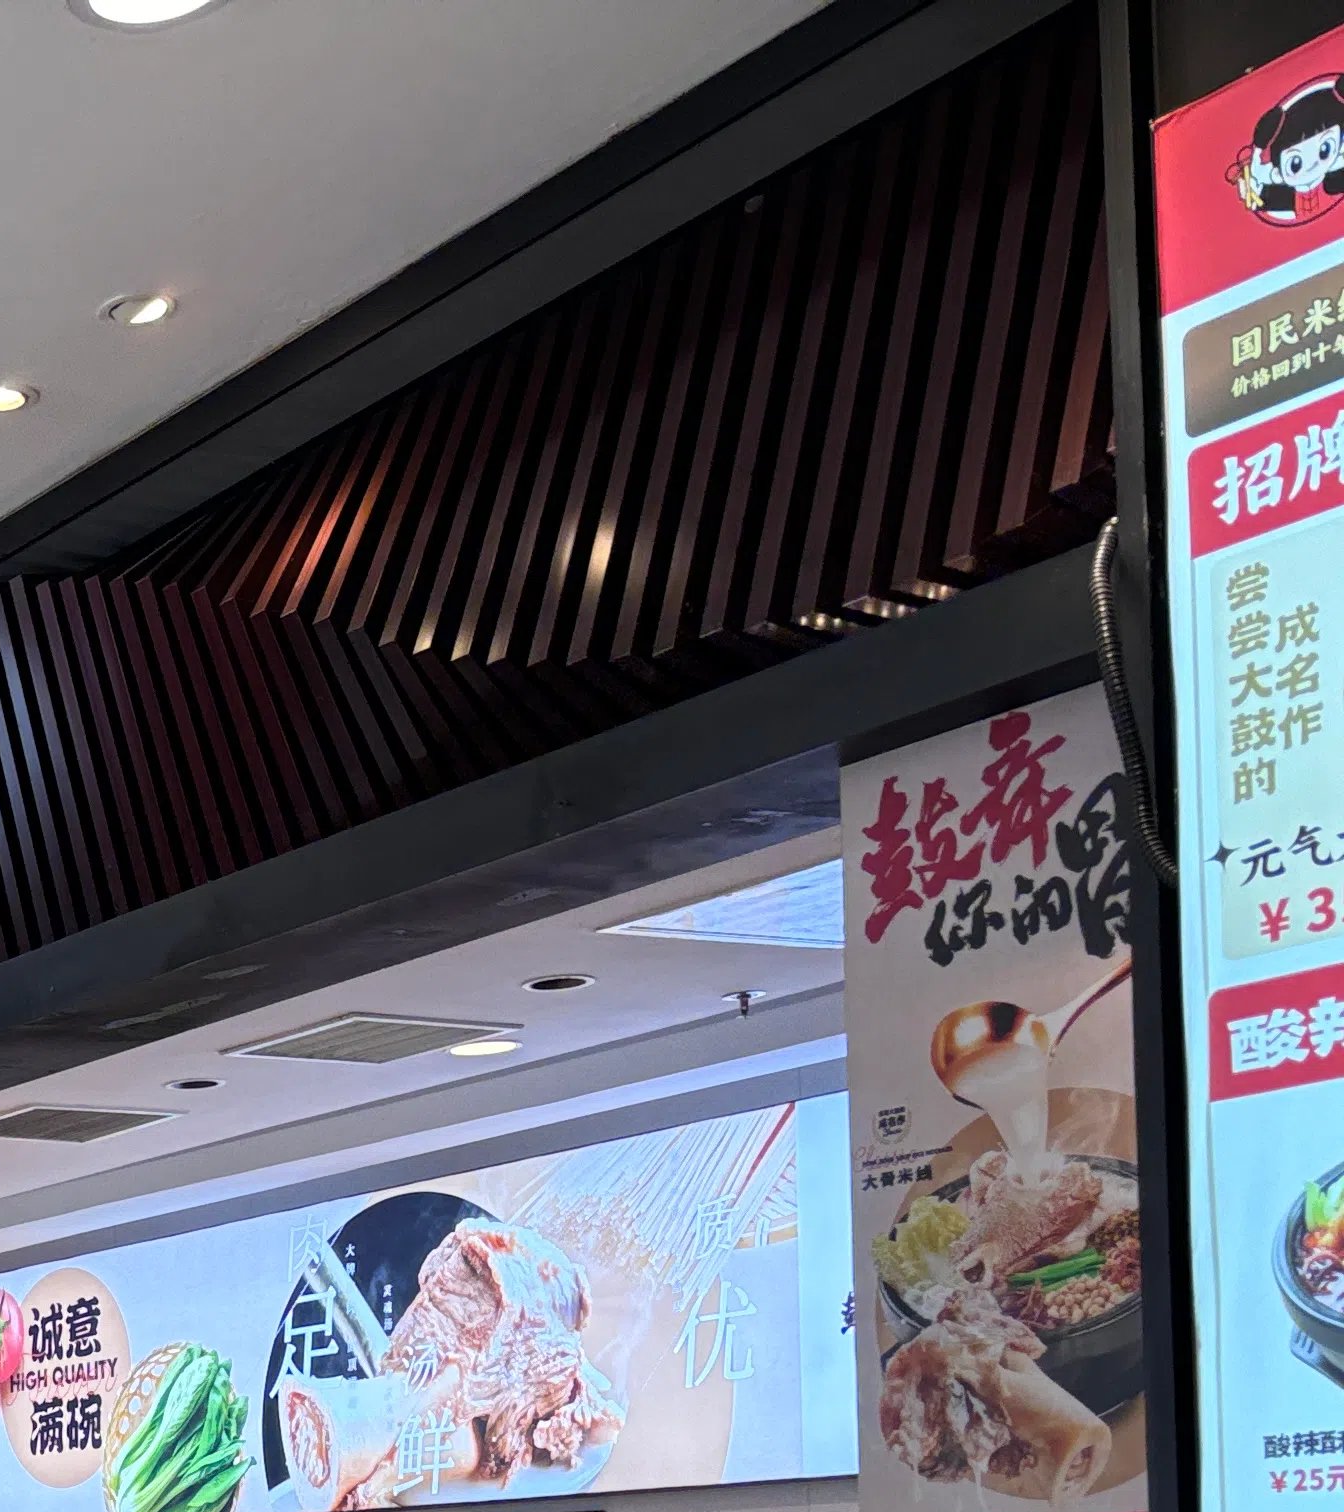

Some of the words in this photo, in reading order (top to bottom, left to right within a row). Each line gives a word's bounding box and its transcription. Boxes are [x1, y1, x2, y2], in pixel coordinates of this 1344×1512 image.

[1232, 288, 1344, 367] 国民米
[1212, 409, 1344, 525] 招牌
[1226, 562, 1277, 804] 尝尝大鼓的
[1274, 601, 1324, 750] 成名作
[1240, 825, 1344, 886] 元气
[1258, 886, 1344, 943] ¥3
[28, 1296, 102, 1363] 诚意
[10, 1369, 48, 1394] HIGH
[52, 1357, 119, 1389] QUALITY
[29, 1396, 103, 1457] 满碗
